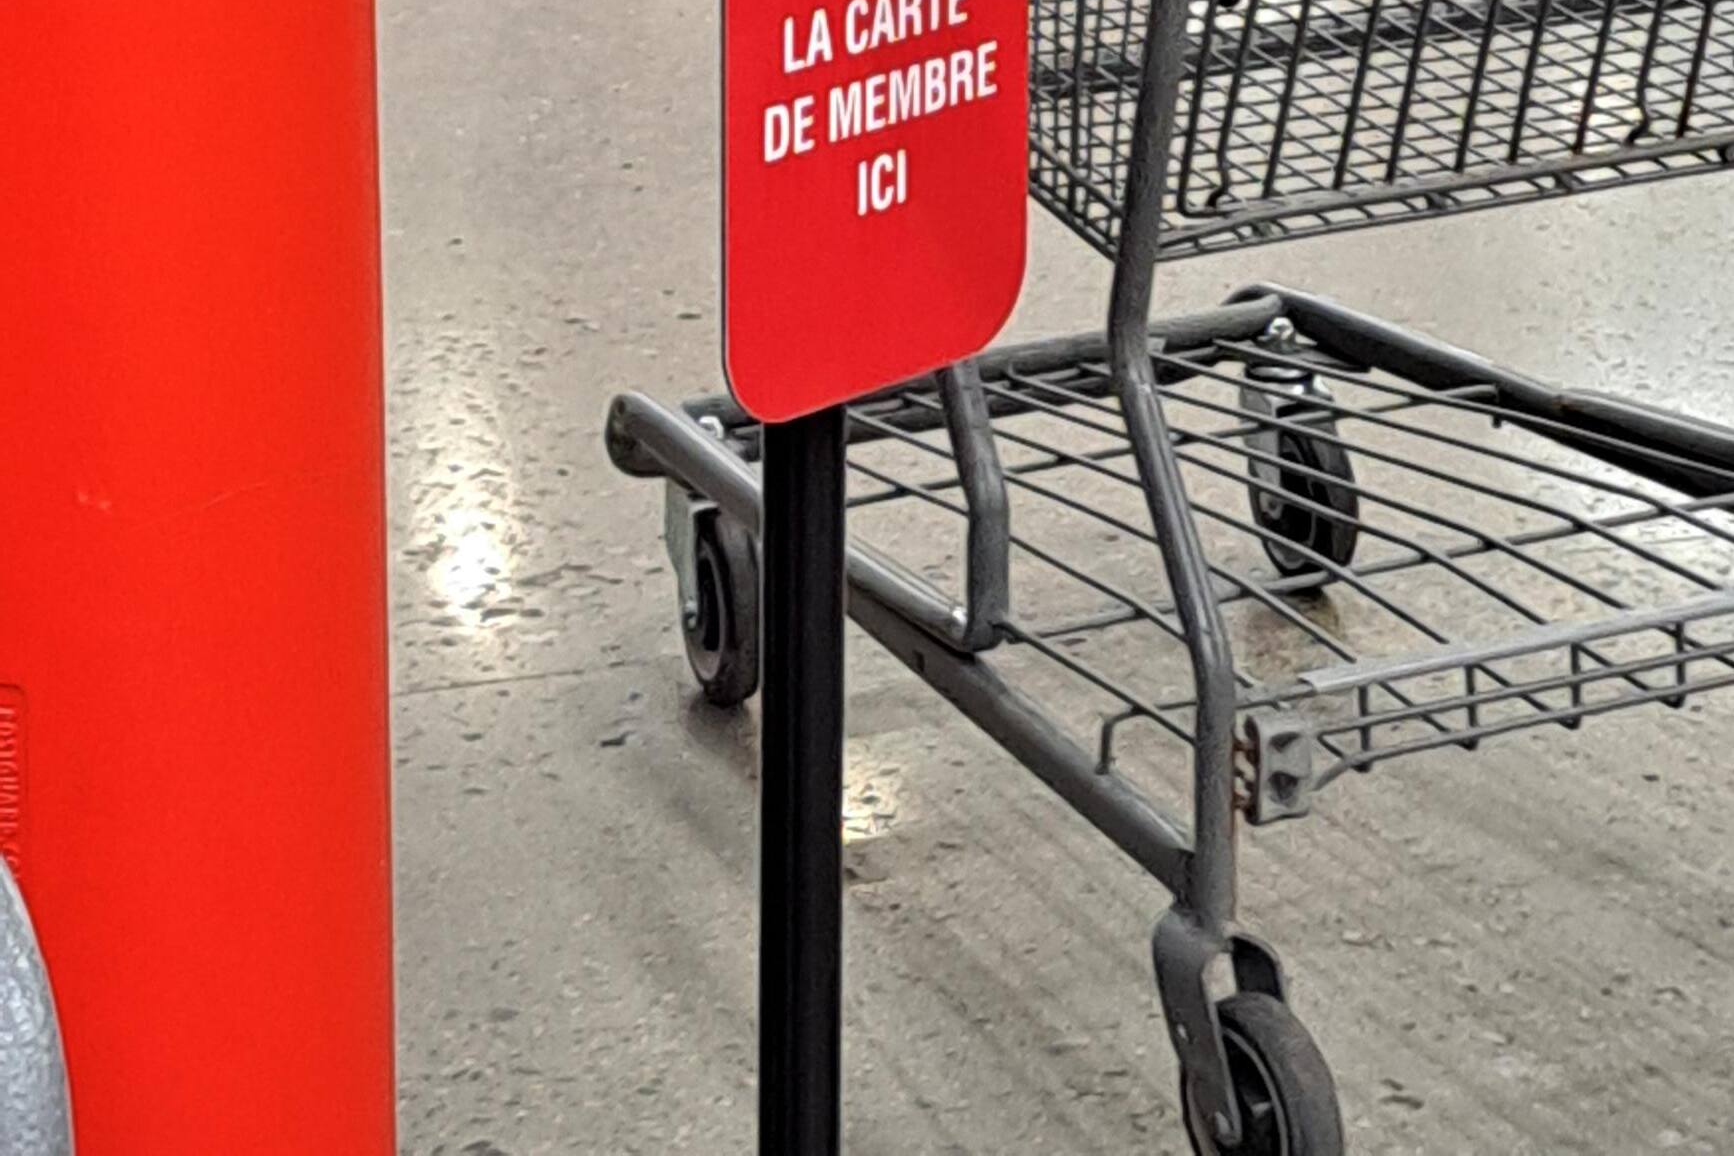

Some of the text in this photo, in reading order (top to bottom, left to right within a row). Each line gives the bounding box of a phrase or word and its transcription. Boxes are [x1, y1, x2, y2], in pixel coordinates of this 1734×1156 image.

[783, 8, 833, 73] LA
[764, 40, 998, 163] DE MEMBRE
[857, 149, 907, 216] ICI
